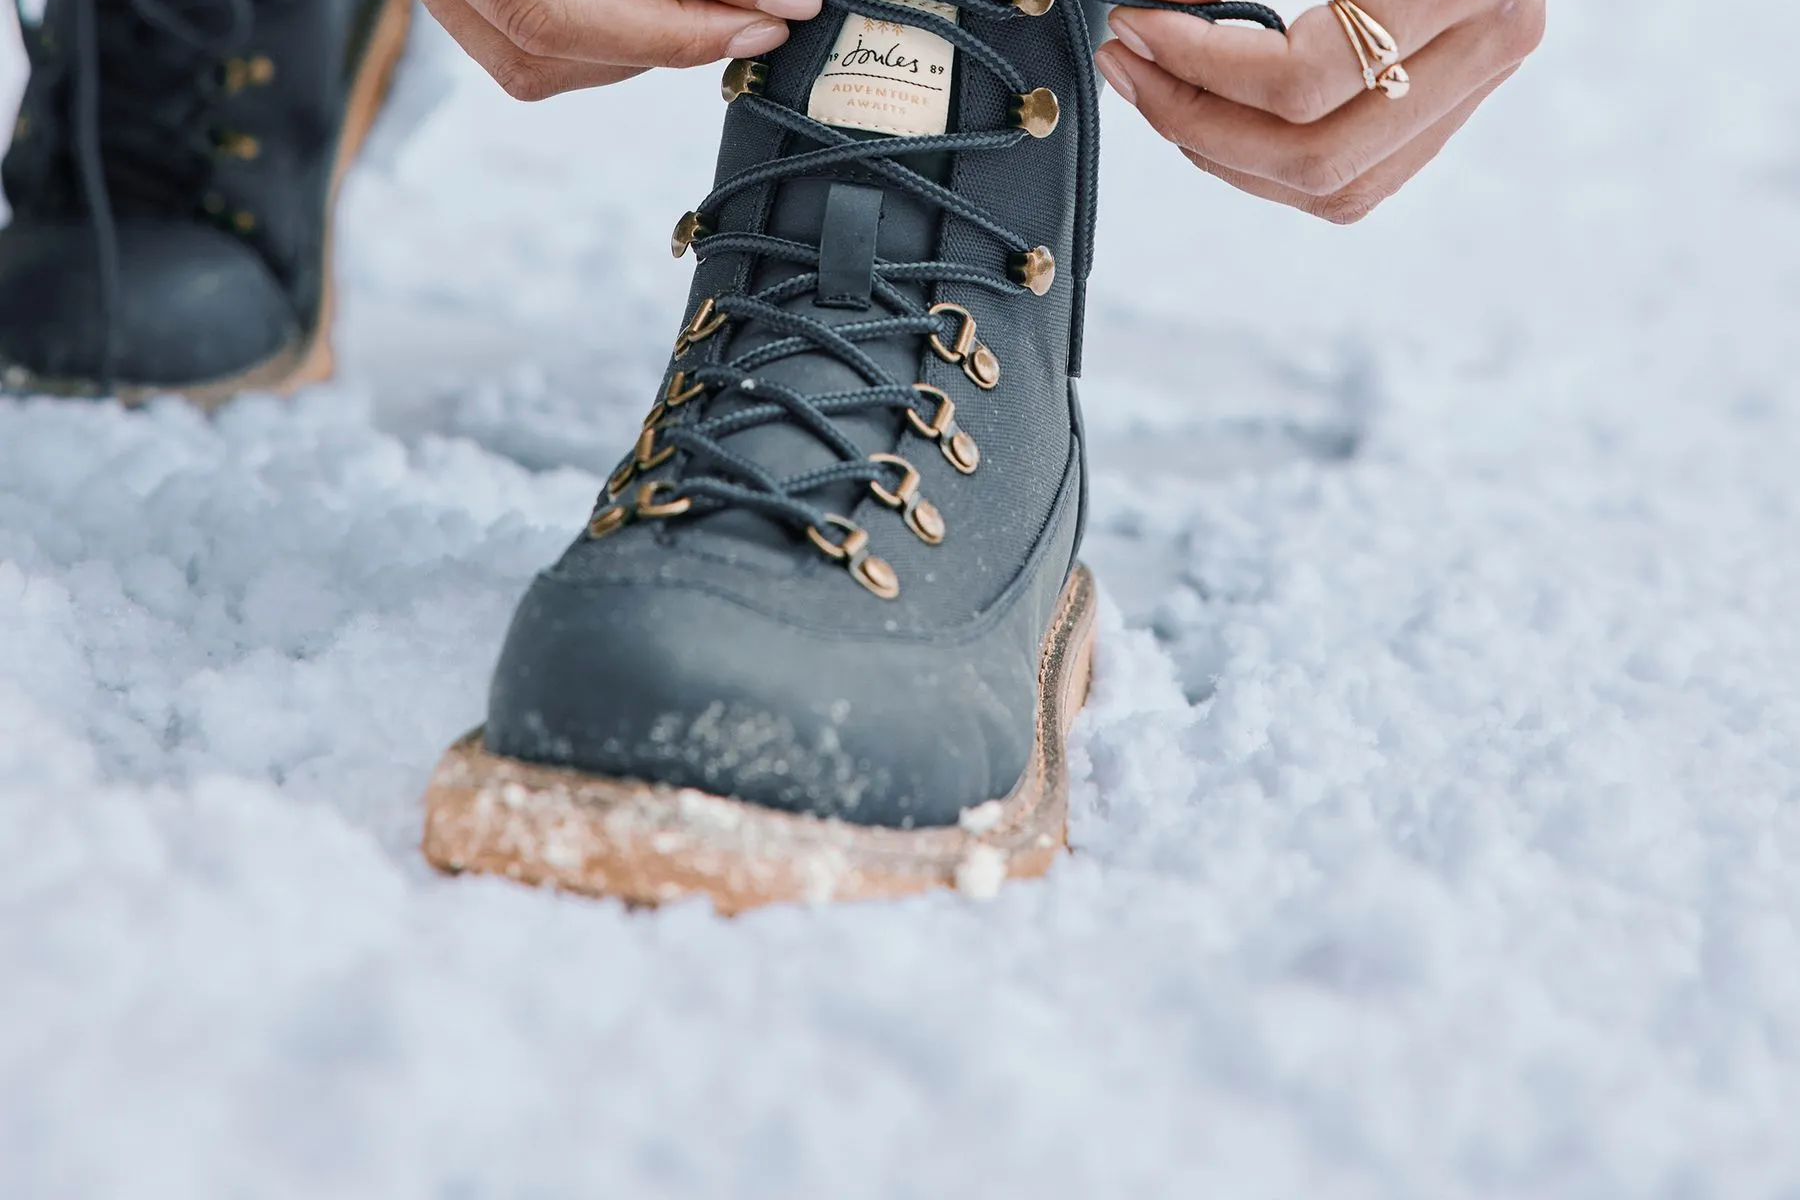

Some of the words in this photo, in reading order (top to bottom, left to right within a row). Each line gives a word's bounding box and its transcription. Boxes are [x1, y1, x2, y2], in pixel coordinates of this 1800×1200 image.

[930, 65, 944, 75] 89
[832, 84, 930, 106] ADVENTURE
[846, 98, 906, 115] AWAITS
